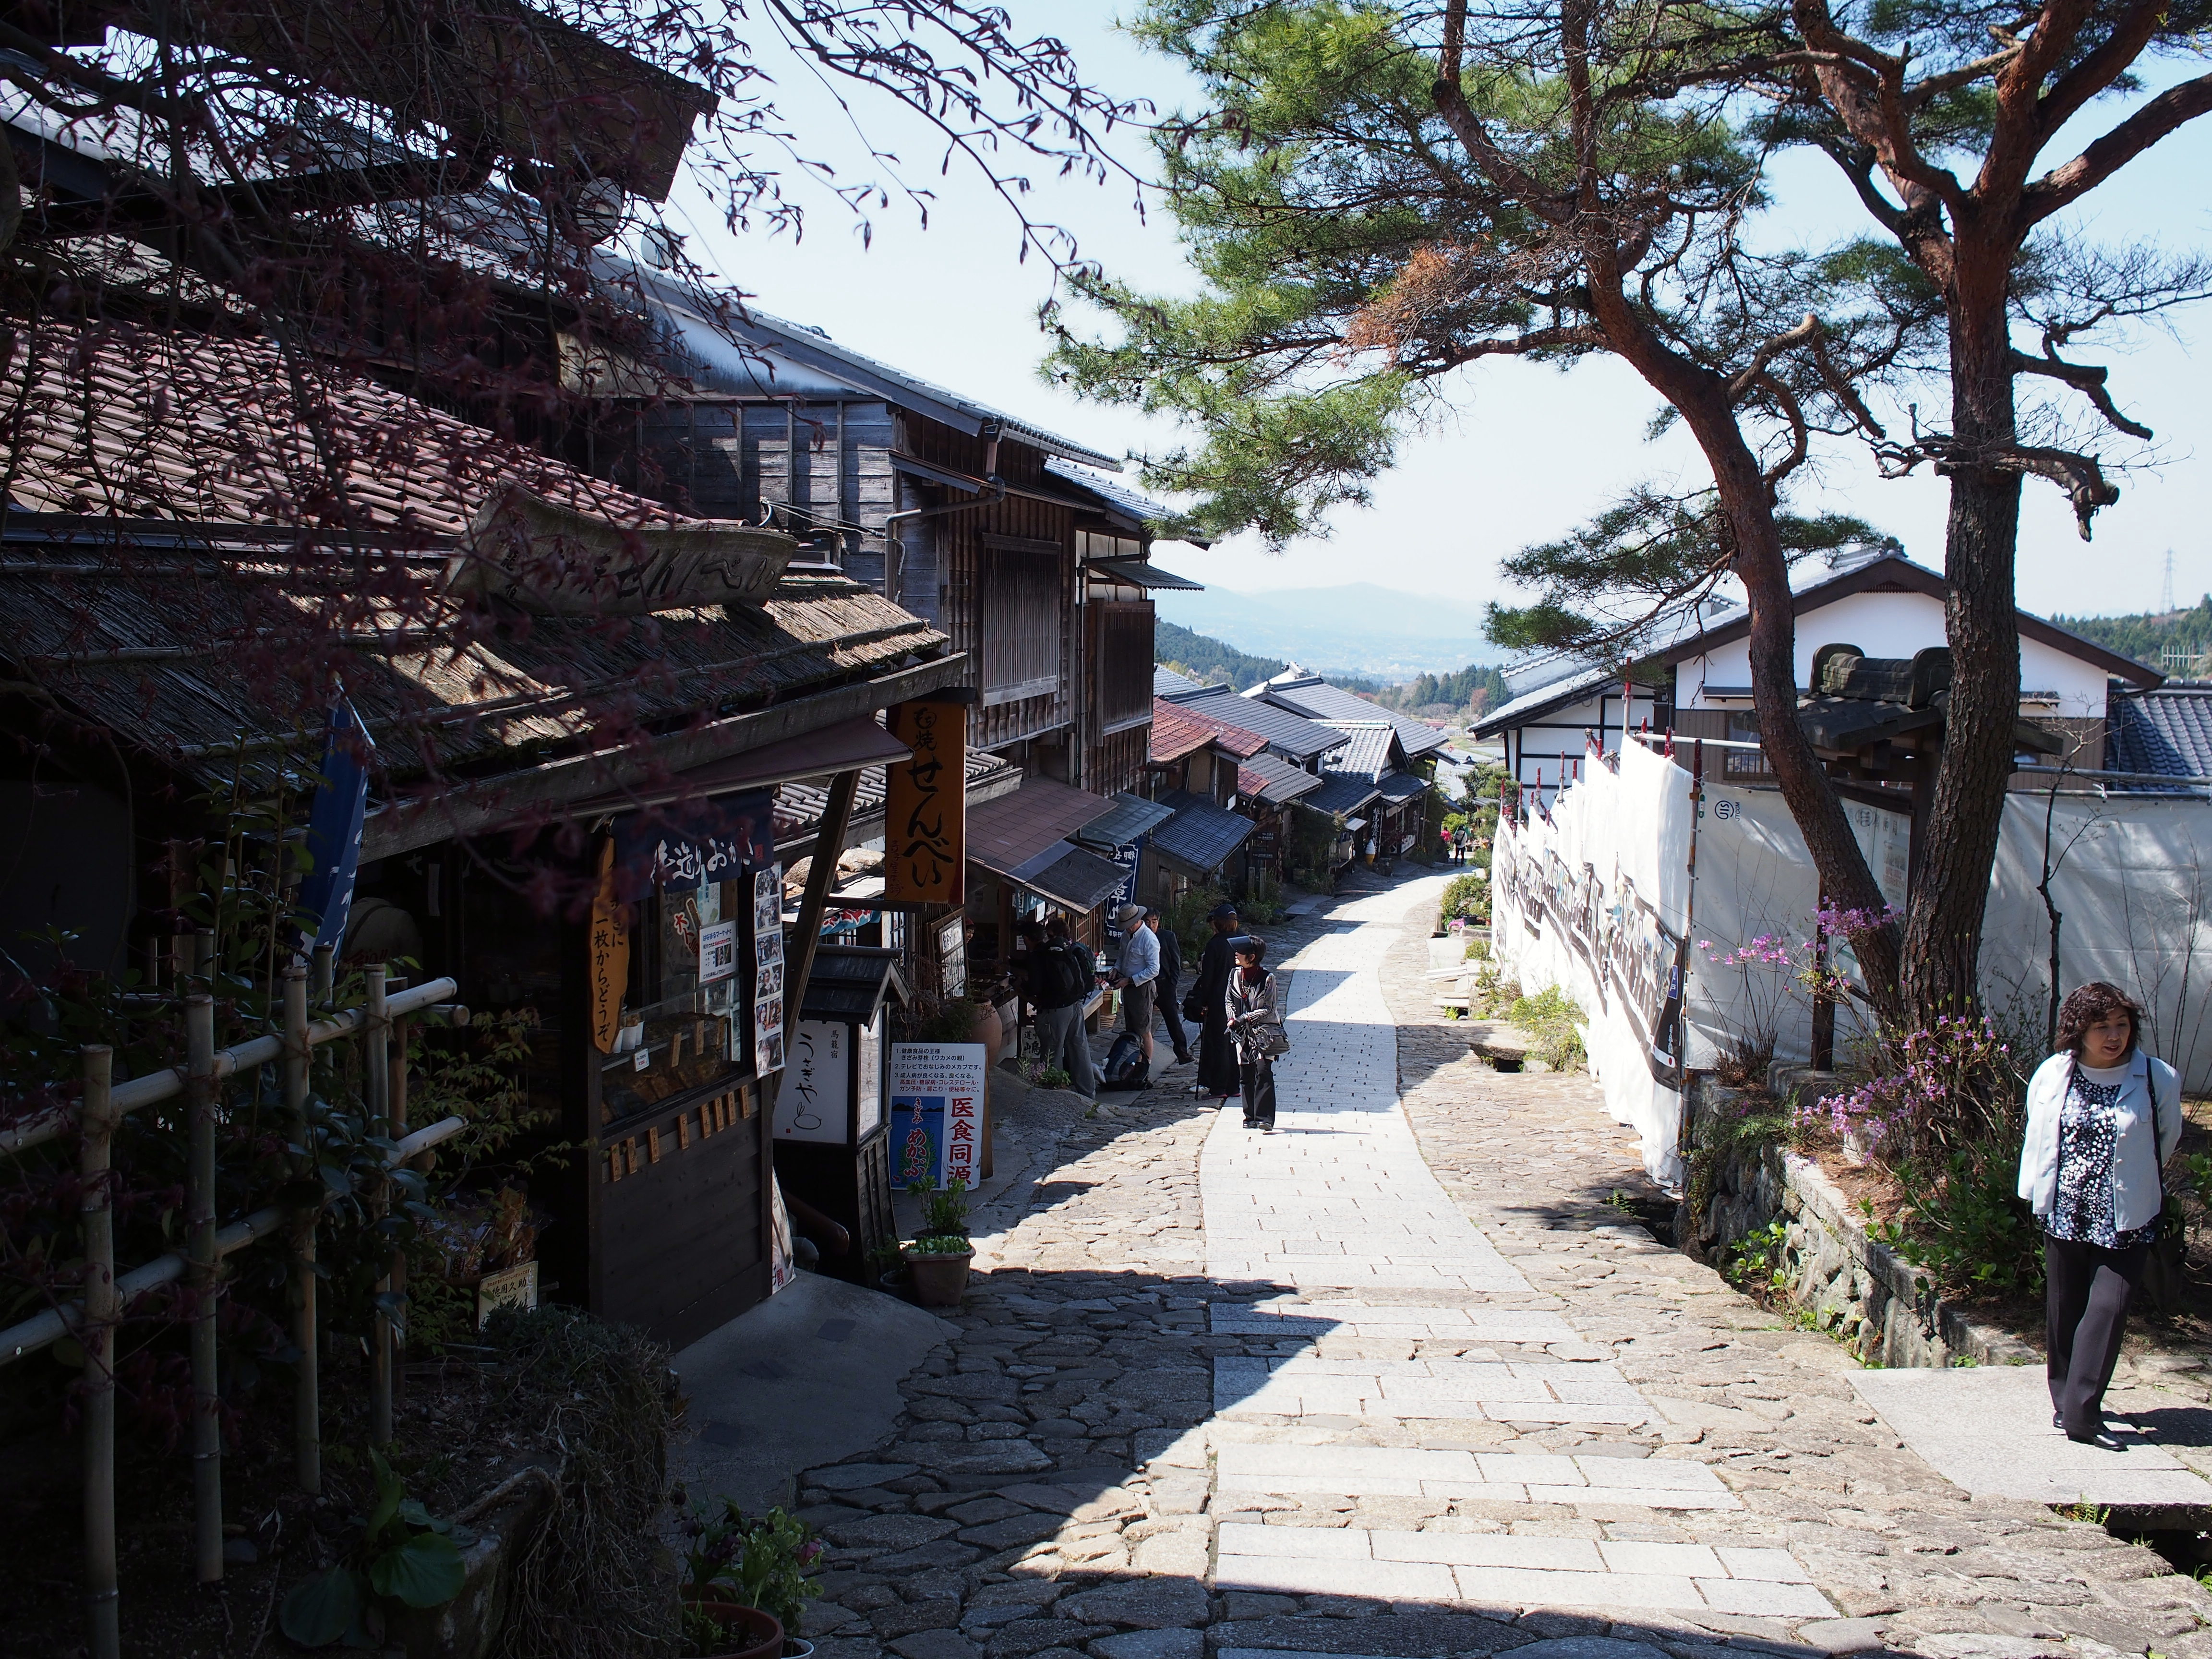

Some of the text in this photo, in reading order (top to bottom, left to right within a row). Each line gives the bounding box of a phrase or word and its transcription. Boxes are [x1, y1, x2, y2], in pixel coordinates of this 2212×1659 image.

[1717, 802, 1731, 819] JIS
[594, 918, 612, 1043] 一枚からどうぞ
[795, 1033, 818, 1104] うさぎや
[830, 1030, 839, 1059] 馬籠宿
[912, 1097, 924, 1124] きざみ
[904, 1128, 927, 1177] めかぶ
[948, 1097, 976, 1186] 医食同源
